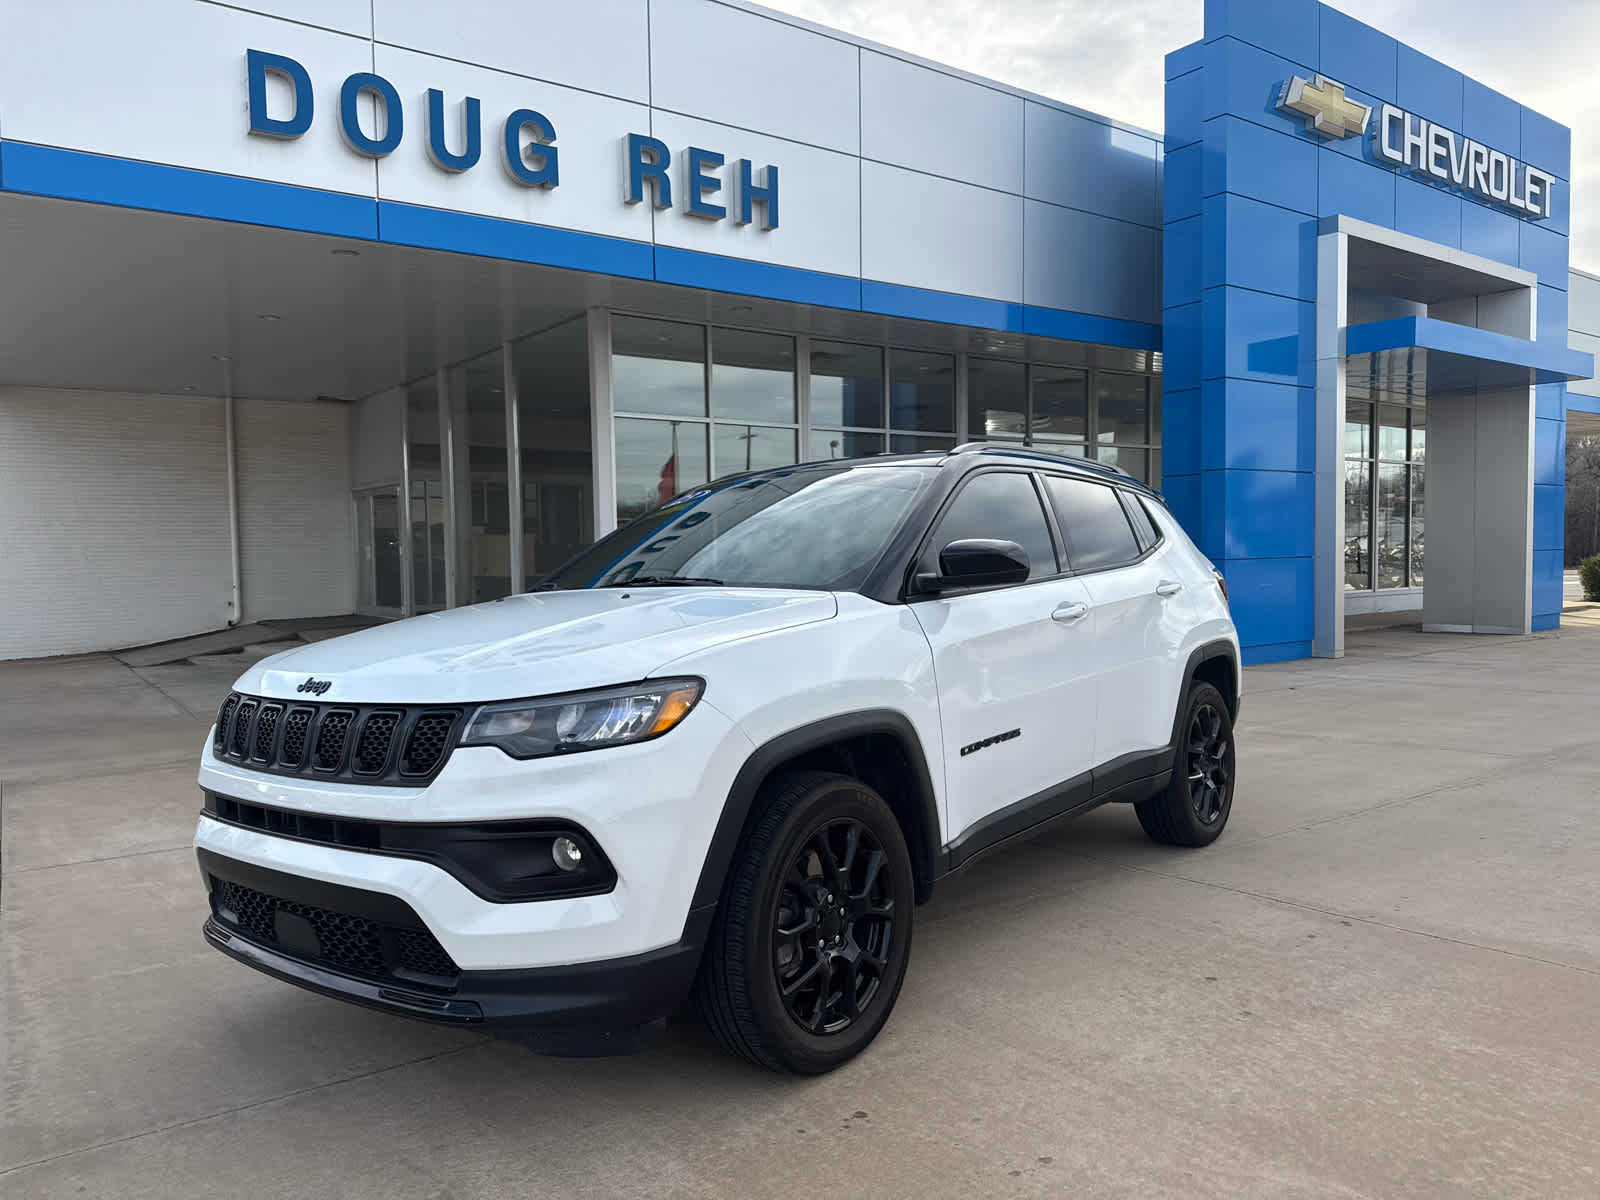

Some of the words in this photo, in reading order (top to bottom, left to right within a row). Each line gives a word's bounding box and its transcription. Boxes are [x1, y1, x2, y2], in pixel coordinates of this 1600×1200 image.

[246, 48, 559, 189] DOUG
[622, 132, 780, 231] REH
[1375, 103, 1556, 219] CHEVROLET
[296, 676, 332, 697] Jeep
